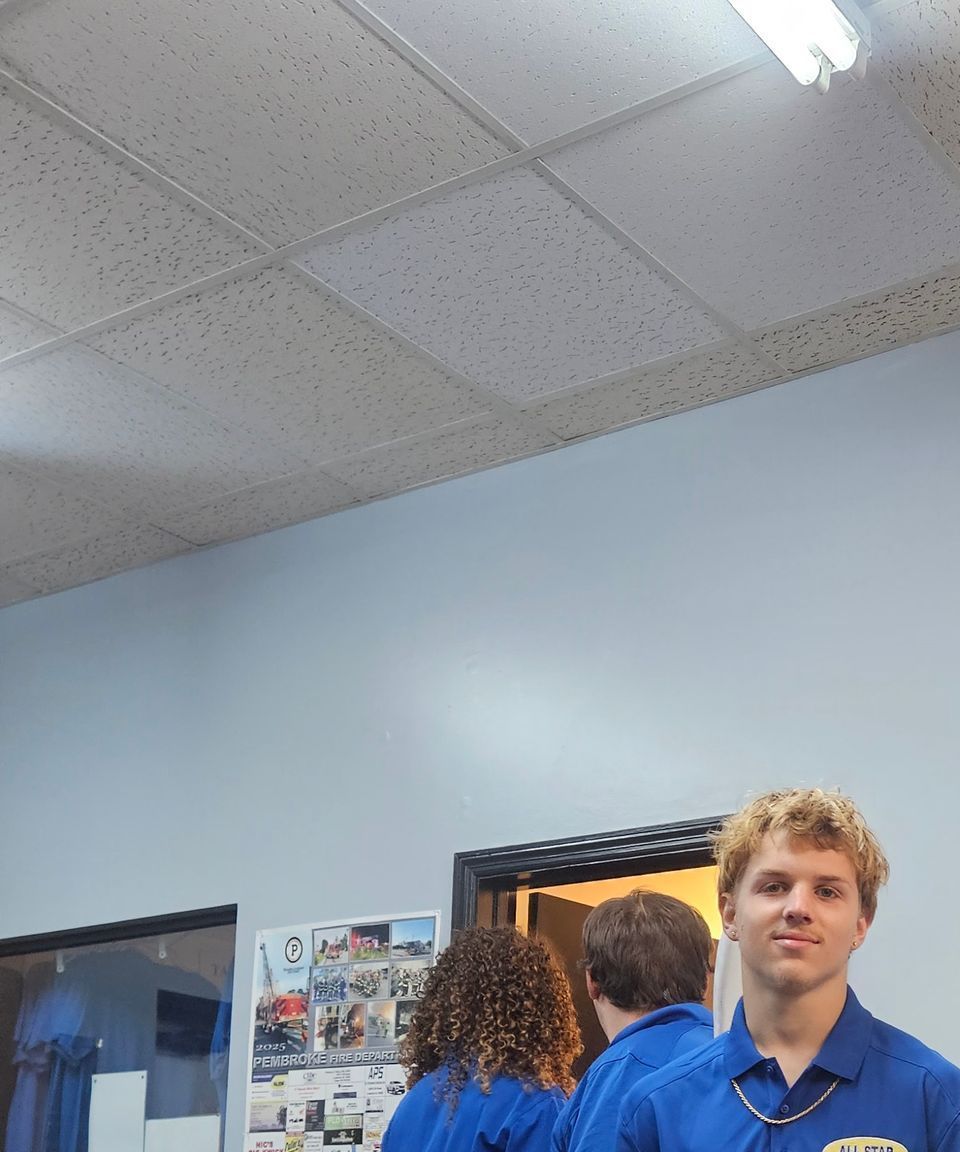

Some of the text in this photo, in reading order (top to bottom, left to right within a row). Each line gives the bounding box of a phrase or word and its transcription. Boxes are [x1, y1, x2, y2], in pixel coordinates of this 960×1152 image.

[255, 1043, 286, 1051] 2025
[253, 1052, 327, 1068] PEMBROKE
[330, 1051, 353, 1063] FIRE
